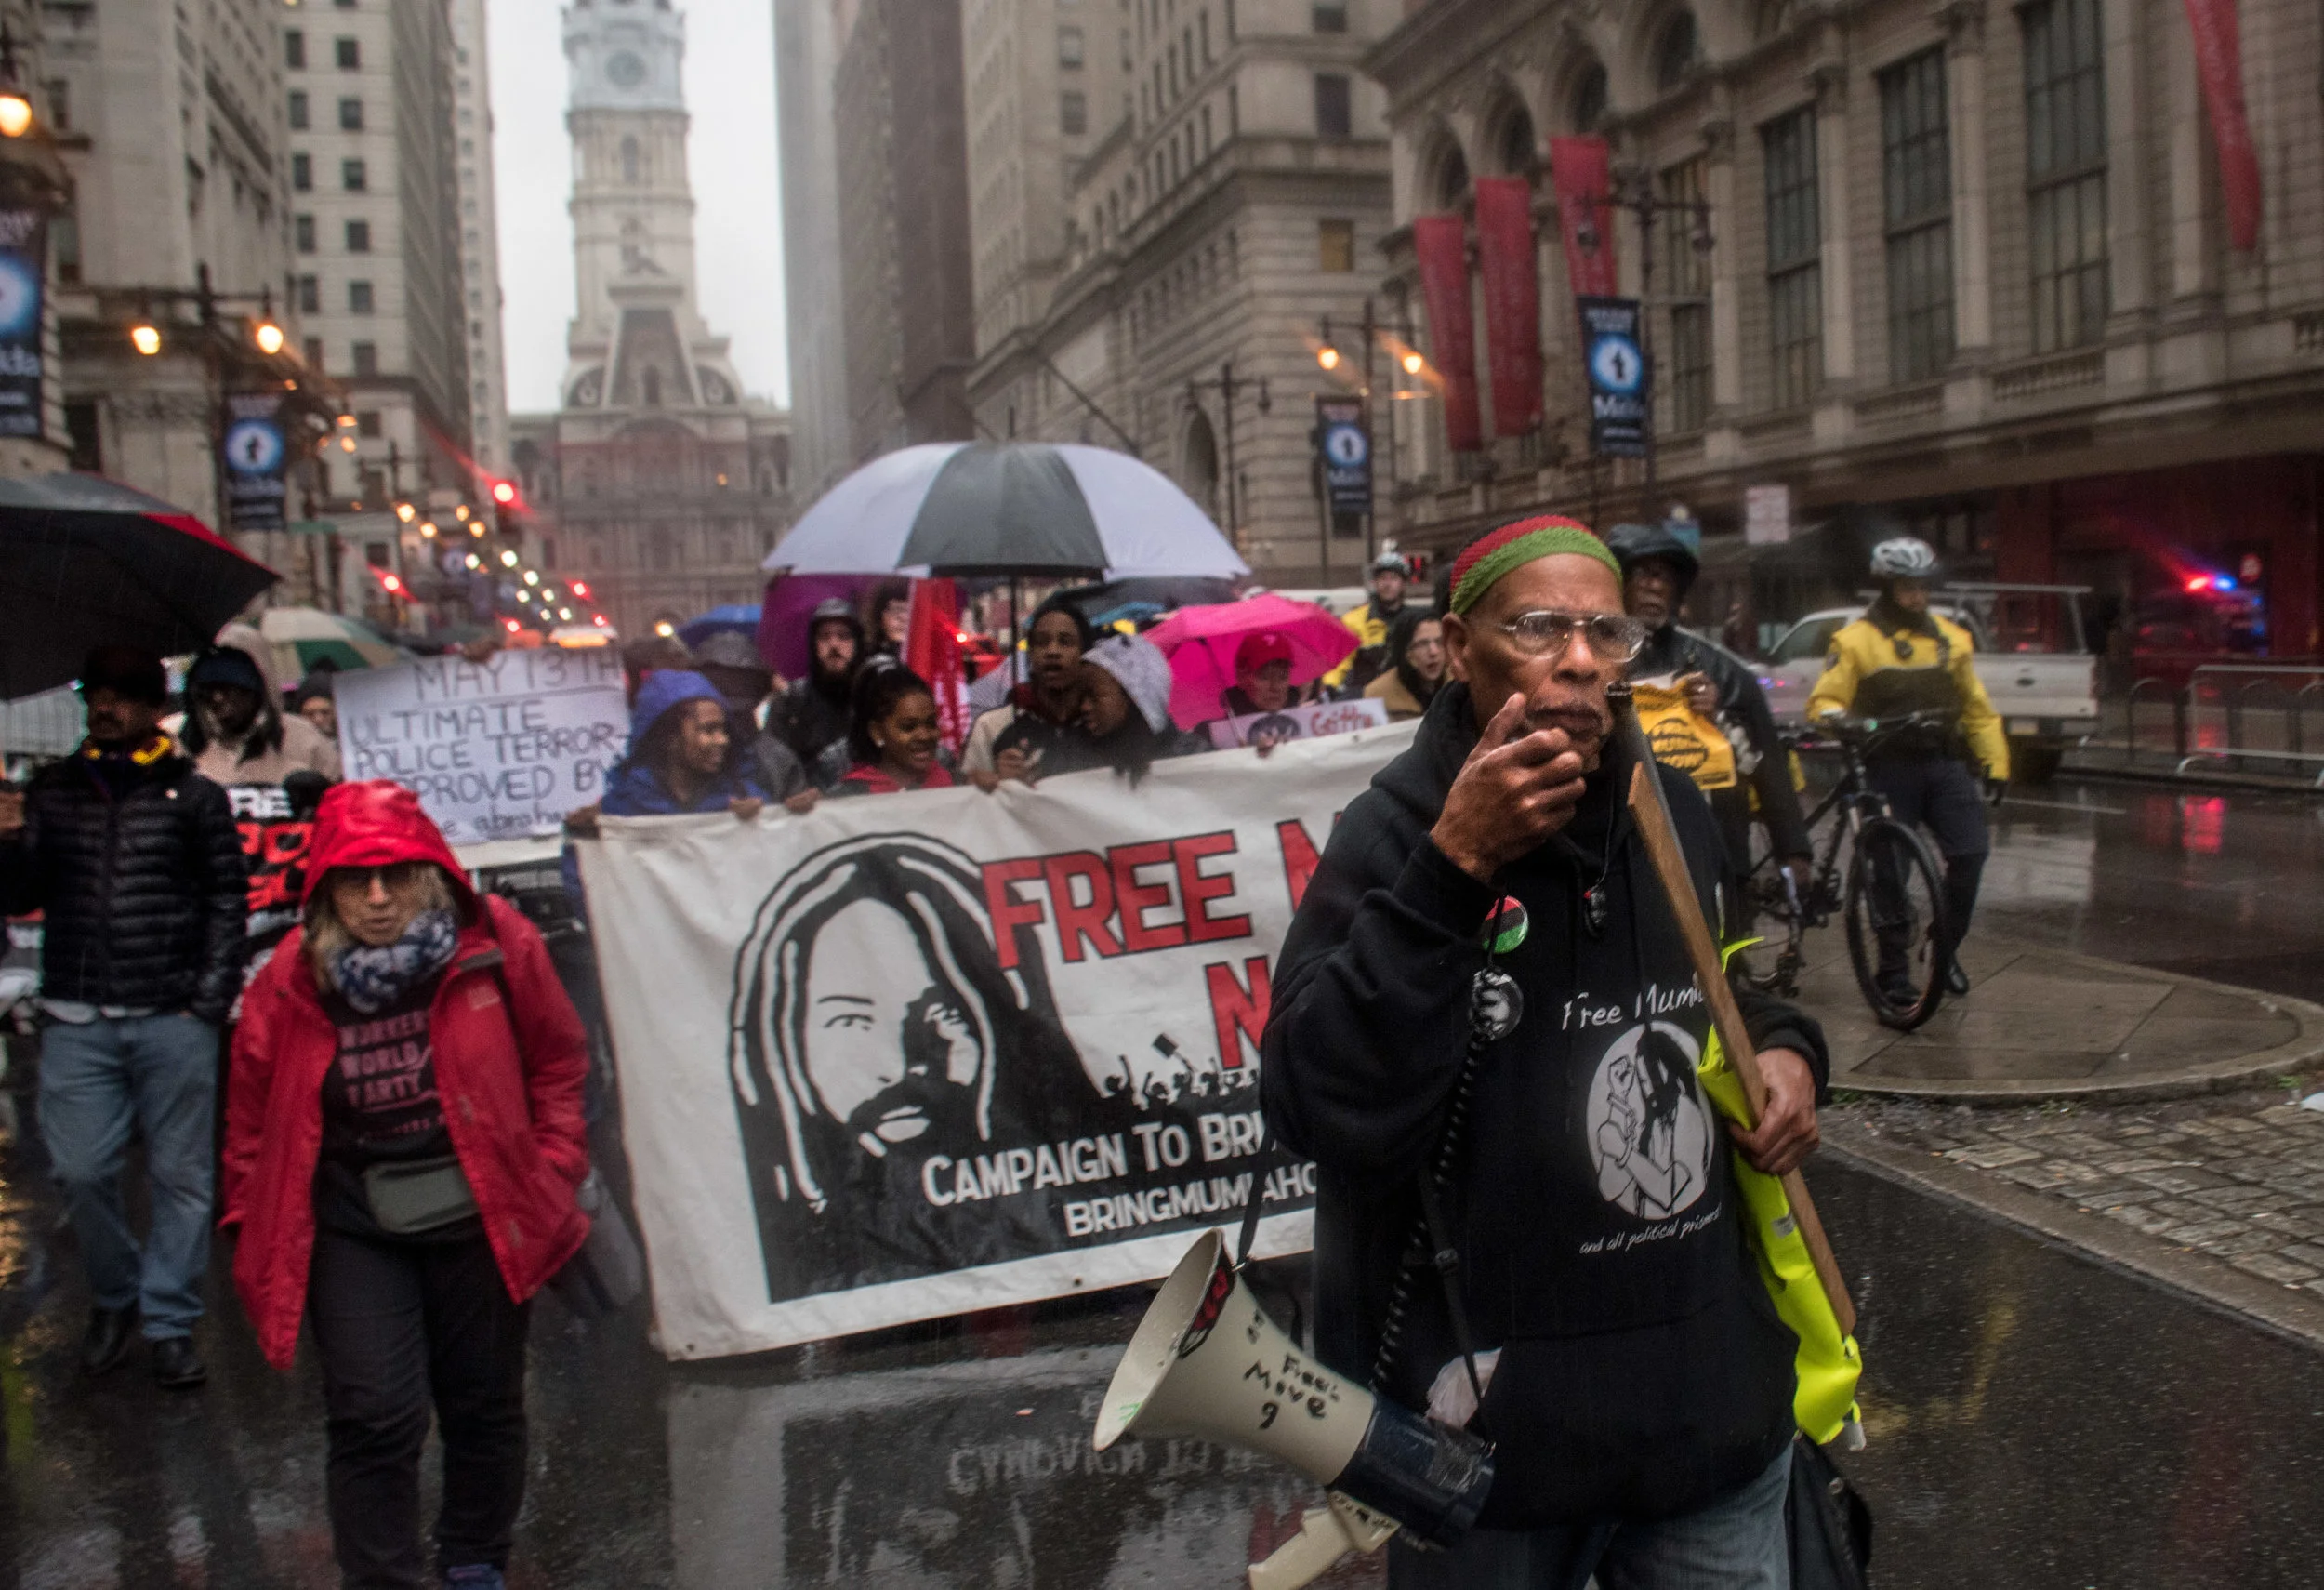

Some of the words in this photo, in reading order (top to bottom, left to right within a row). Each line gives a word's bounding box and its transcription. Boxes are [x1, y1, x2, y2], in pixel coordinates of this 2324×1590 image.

[413, 653, 508, 701] MAY
[348, 699, 548, 746] ULTIMATE
[354, 737, 473, 779] POLICE
[485, 722, 616, 765] TERROR
[980, 829, 1253, 969] FREE
[1562, 991, 1623, 1030] Free
[921, 1132, 1129, 1207] CAMPAIGN
[1131, 1120, 1191, 1172] TO
[1197, 1110, 1267, 1162] BRI
[1578, 1236, 1604, 1254] and
[1606, 1231, 1626, 1251] all
[1625, 1218, 1679, 1252] political
